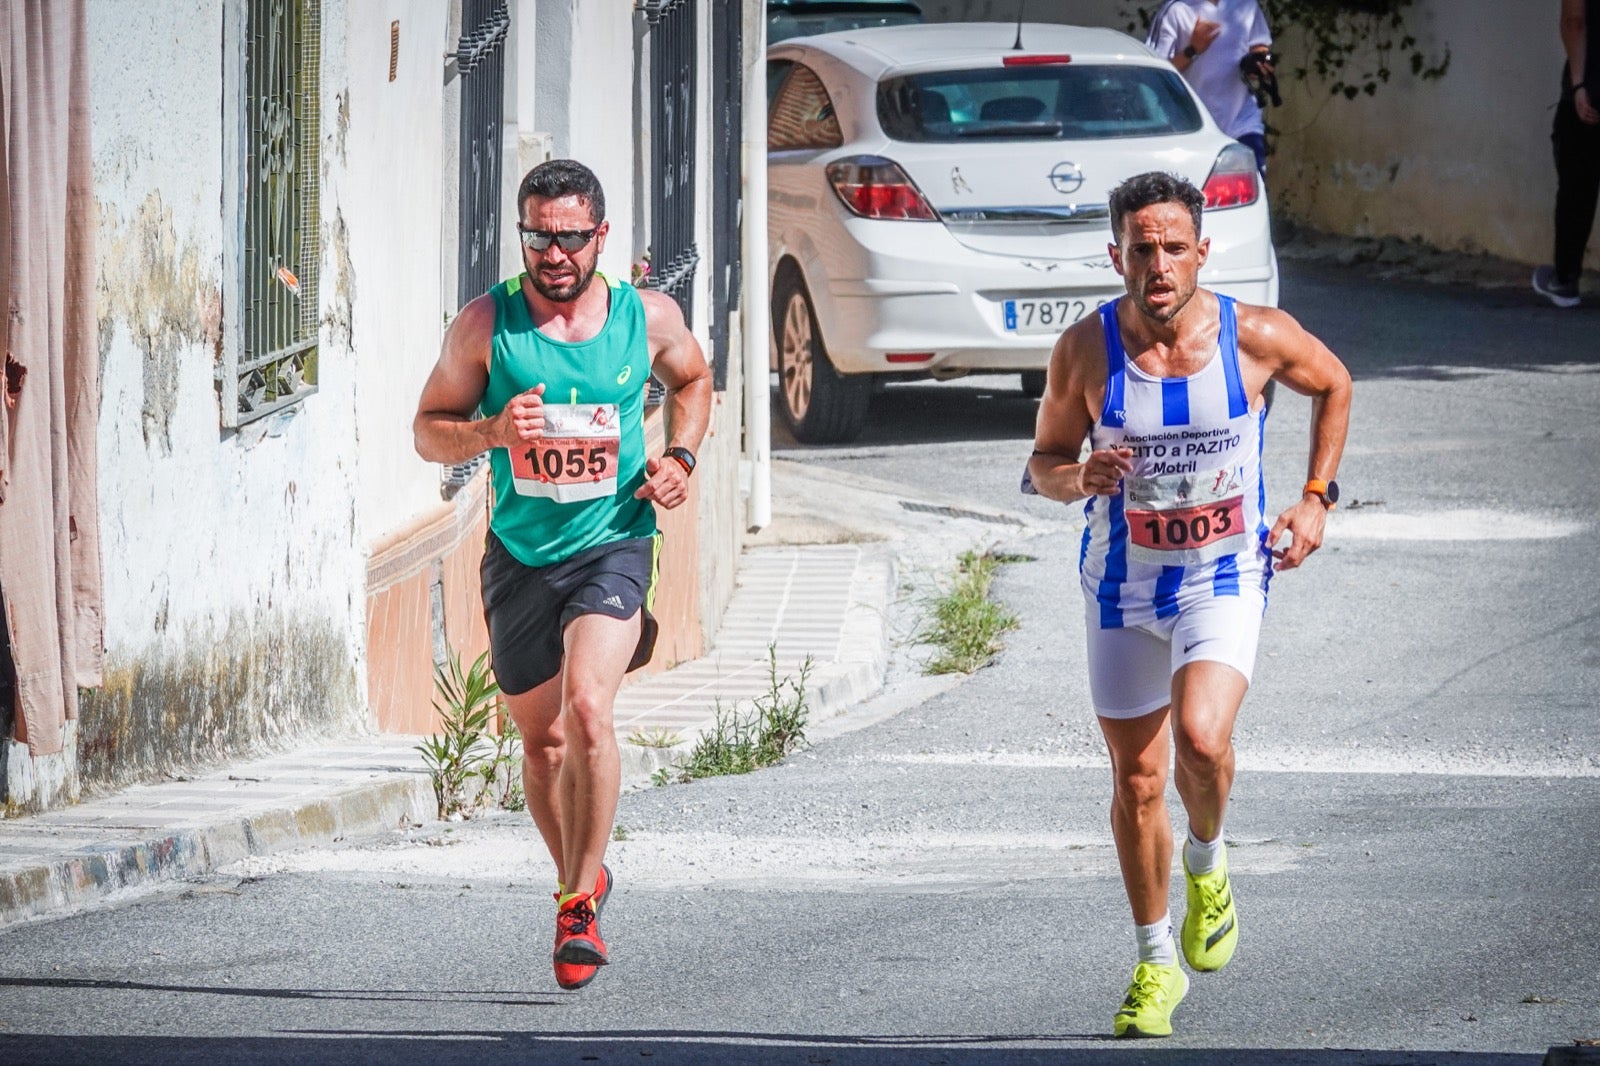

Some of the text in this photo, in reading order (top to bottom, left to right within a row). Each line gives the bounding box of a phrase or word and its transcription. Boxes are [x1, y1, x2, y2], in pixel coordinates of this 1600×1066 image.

[1022, 301, 1085, 326] 7872
[1110, 434, 1241, 458] ZITO a PAZITO
[1123, 427, 1230, 443] Asociación Deportiva
[524, 446, 607, 479] 1055
[1153, 460, 1197, 474] Motril
[1145, 507, 1232, 545] 1003
